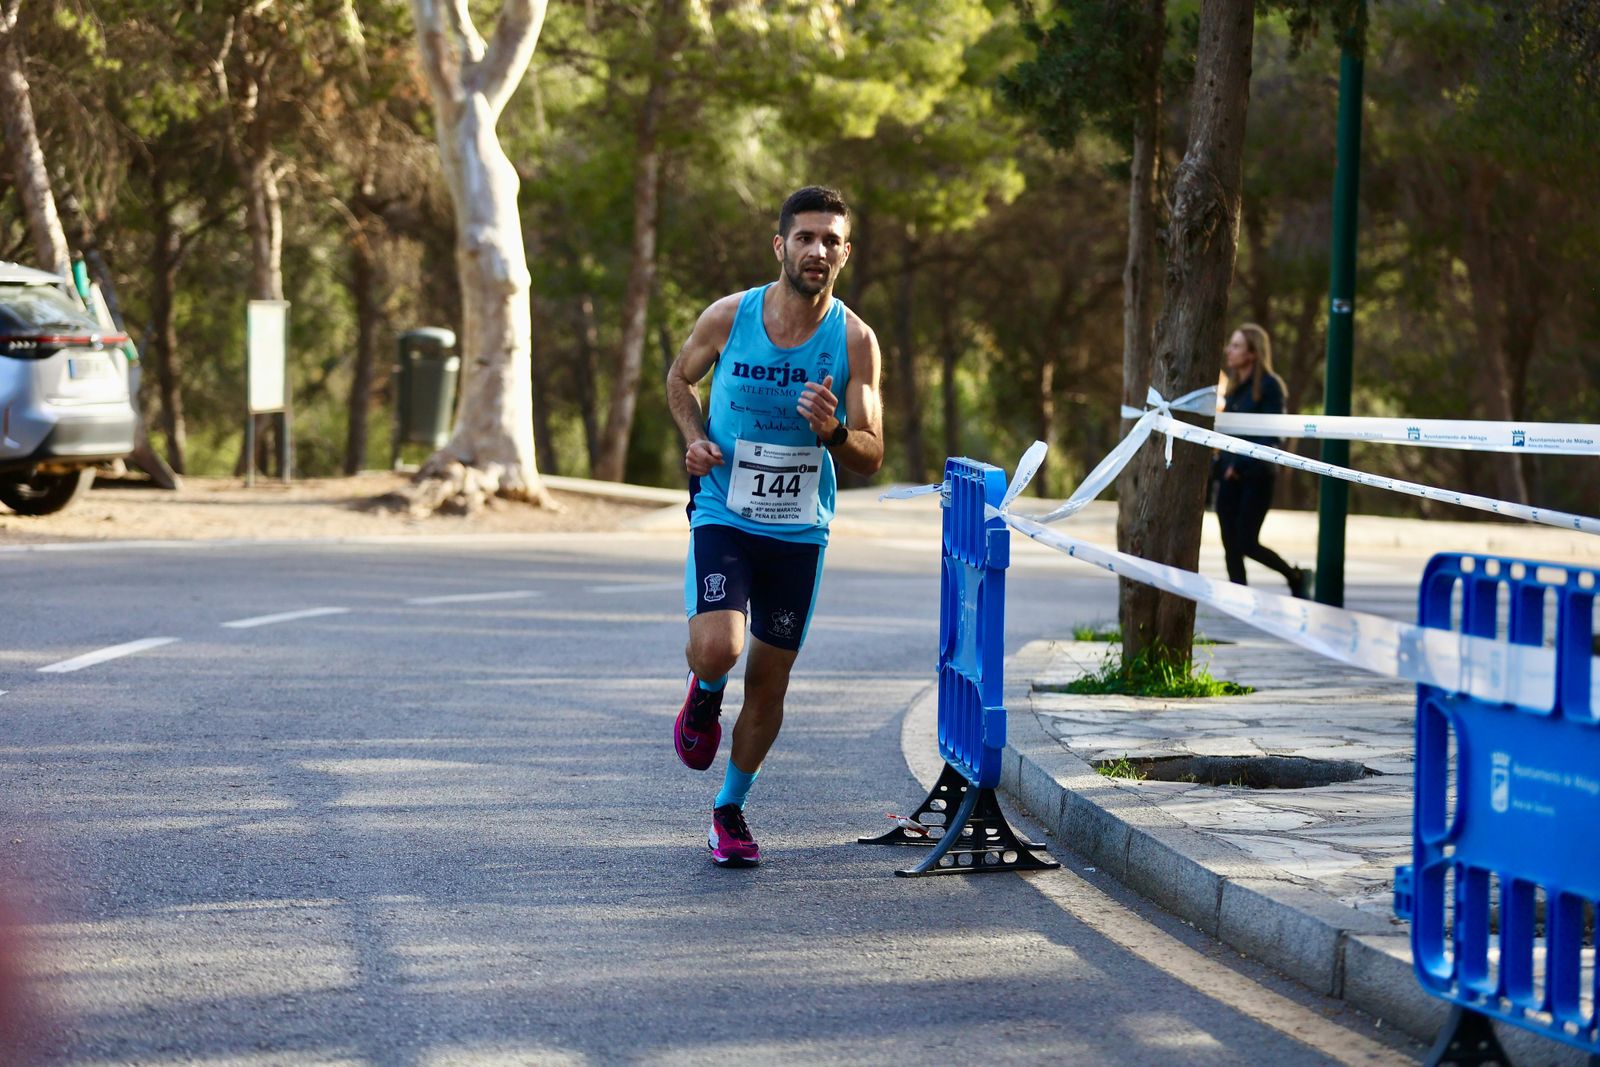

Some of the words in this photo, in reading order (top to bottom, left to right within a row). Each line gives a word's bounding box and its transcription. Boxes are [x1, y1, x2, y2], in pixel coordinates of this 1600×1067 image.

[732, 361, 808, 387] nerja
[740, 384, 797, 397] ATLETISMO
[752, 473, 801, 498] 144
